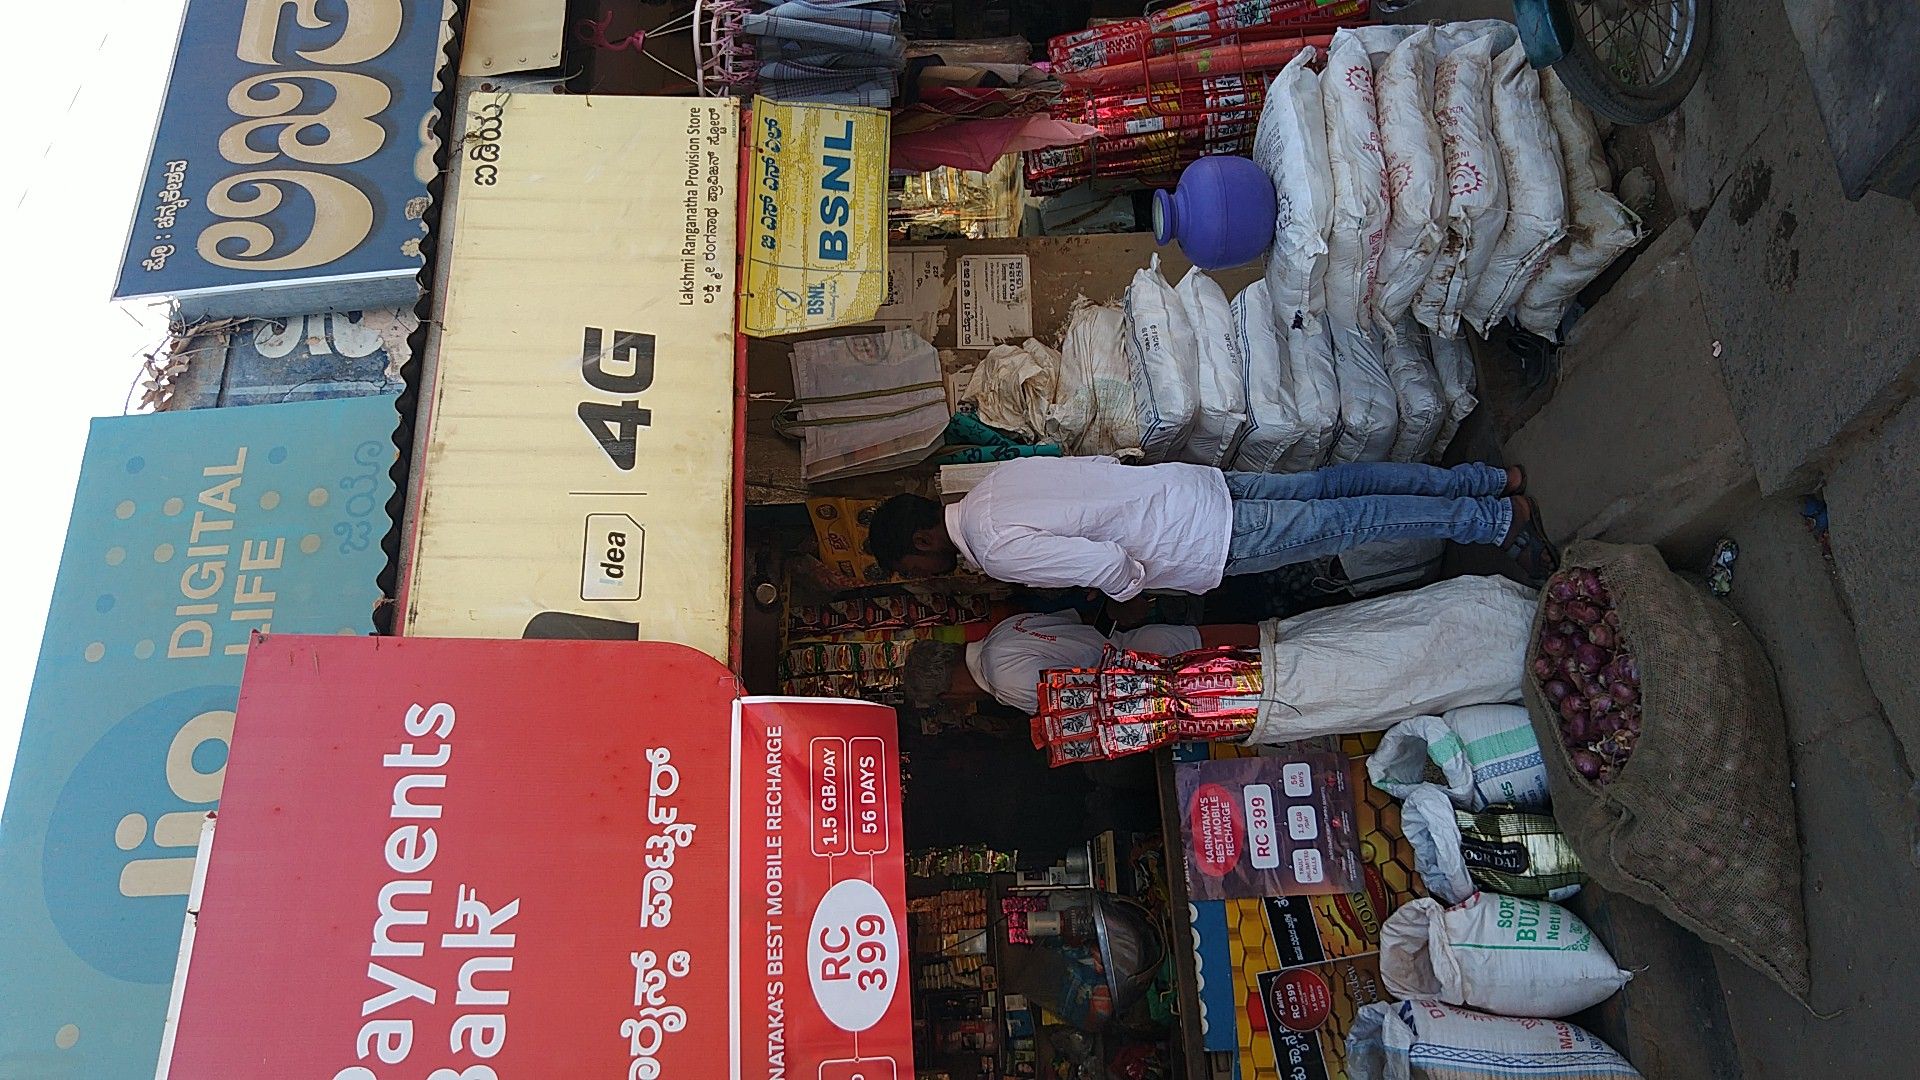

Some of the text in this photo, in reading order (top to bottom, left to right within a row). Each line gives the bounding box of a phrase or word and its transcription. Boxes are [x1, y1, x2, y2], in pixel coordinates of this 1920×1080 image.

[679, 107, 700, 305] Lakshmi Ranganatha Provision Store
[818, 120, 853, 261] BSNL
[807, 282, 825, 315] BSNL
[577, 326, 656, 471] 4G
[167, 446, 248, 659] DIGITAL
[766, 725, 783, 830] RECHARGE
[822, 748, 838, 846] 1.5 GB/DAY
[859, 755, 877, 834] 56 DAYS
[1200, 797, 1215, 863] KARNATAKA'S
[1210, 795, 1226, 863] BEST MOBILE
[1221, 801, 1235, 856] RECHARGE
[1251, 797, 1270, 857] RC 399
[1464, 850, 1492, 861] OOR
[767, 835, 783, 916] MOBILE
[1352, 892, 1379, 935] GOLD
[1546, 918, 1560, 940] Nett
[767, 921, 783, 975] BEST
[819, 925, 852, 981] RC
[855, 914, 888, 992] 399
[1286, 983, 1301, 1019] RC 399
[1345, 964, 1366, 1005] neydew
